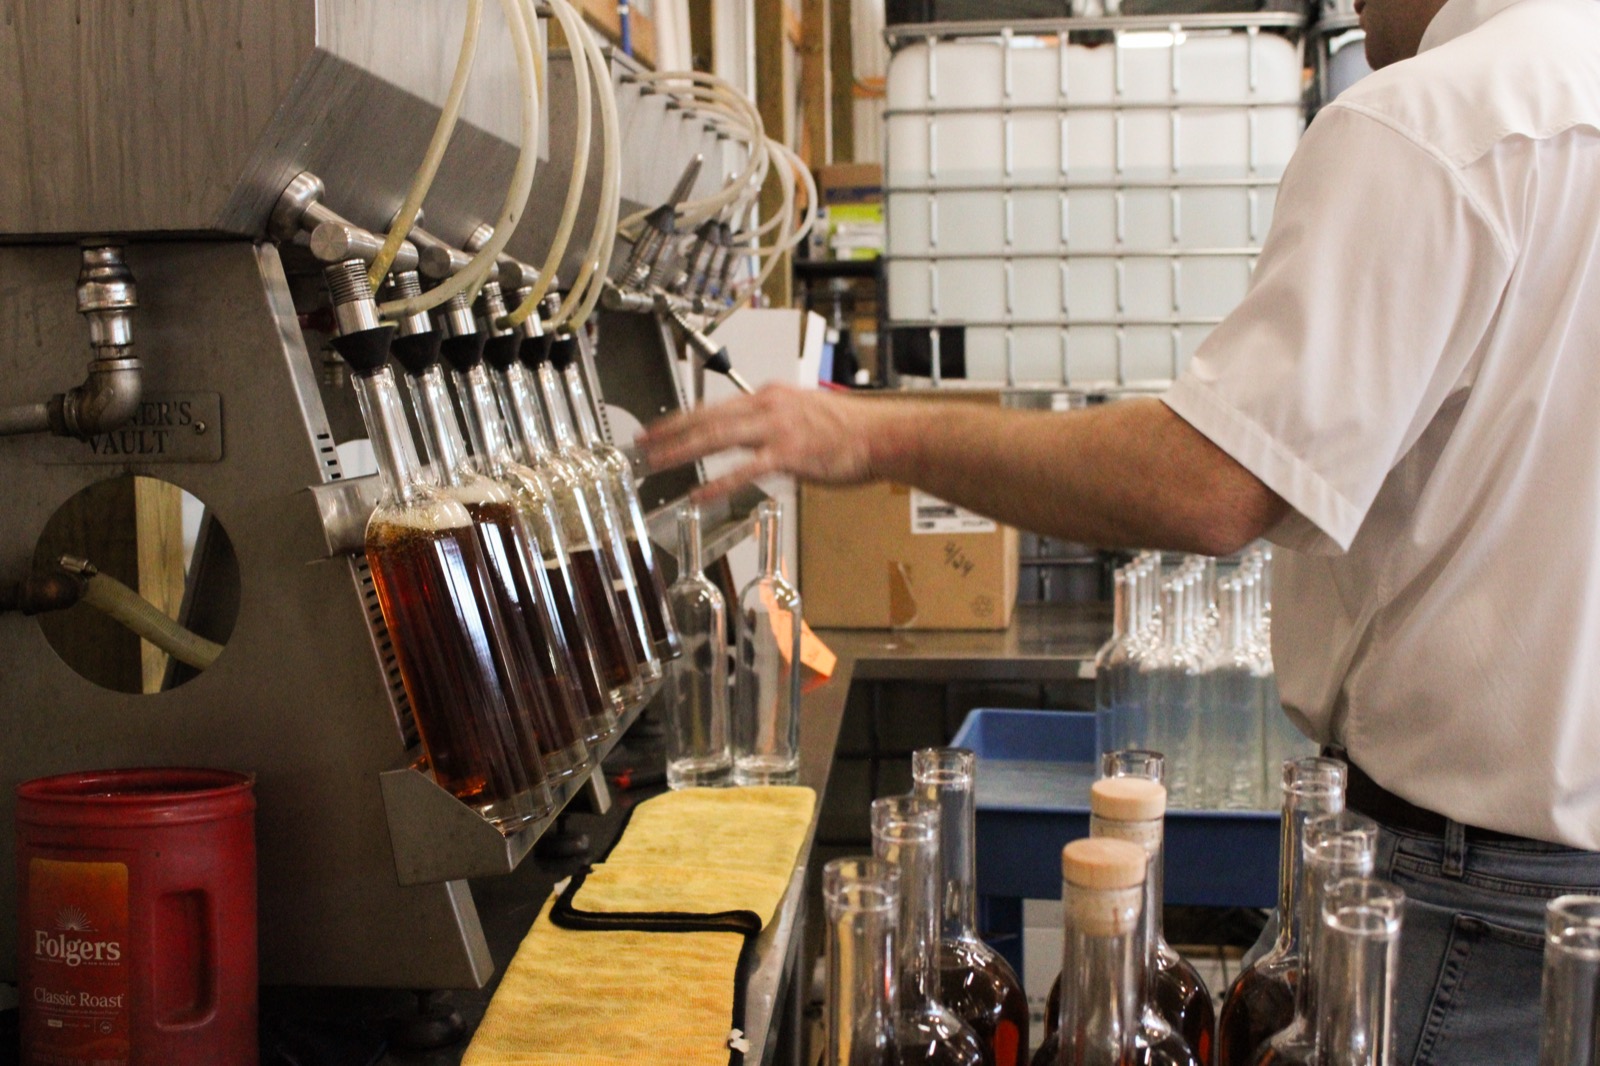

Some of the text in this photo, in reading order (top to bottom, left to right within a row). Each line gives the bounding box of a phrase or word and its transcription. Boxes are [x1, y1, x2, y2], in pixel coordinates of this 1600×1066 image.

[89, 430, 169, 454] VAULT
[34, 930, 121, 967] Folgers
[33, 986, 124, 1008] Classic Roast
